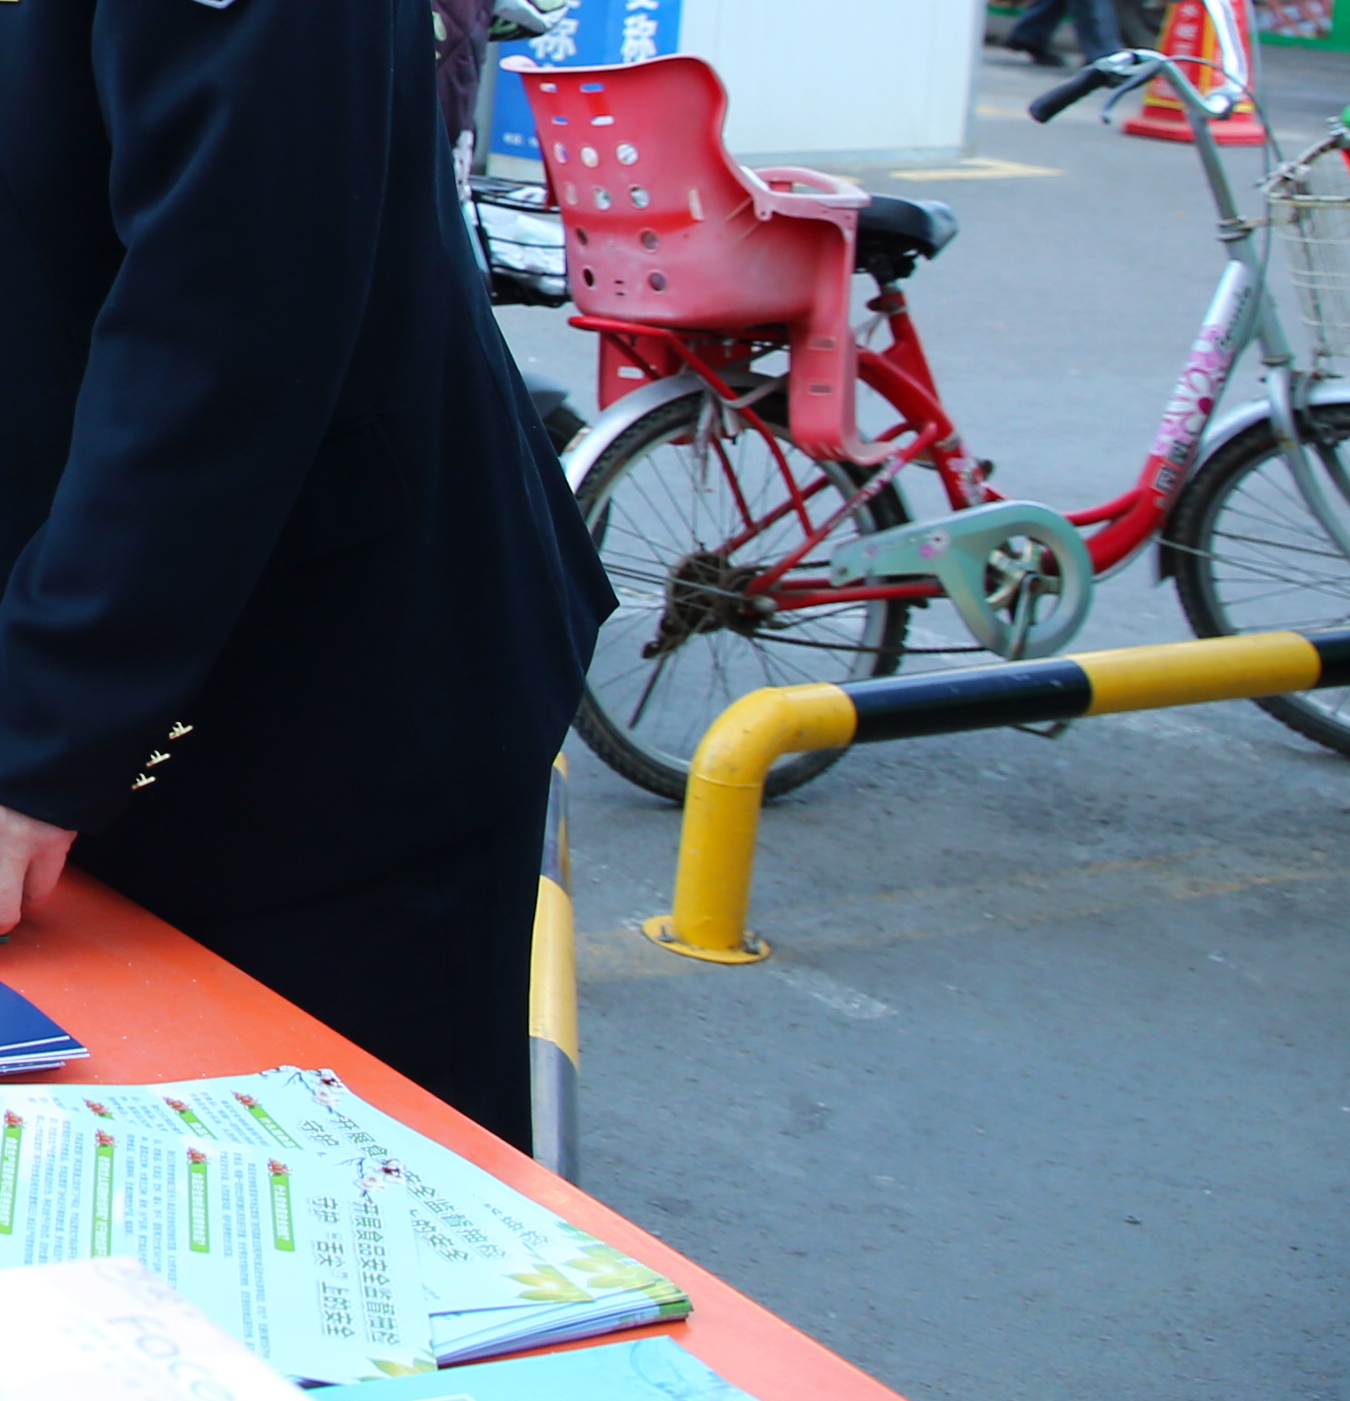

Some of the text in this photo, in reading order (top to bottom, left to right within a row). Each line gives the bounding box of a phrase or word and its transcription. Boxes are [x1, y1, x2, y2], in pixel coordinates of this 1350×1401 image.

[329, 1114, 507, 1260] 开展食安全监督抽检
[352, 1197, 401, 1345] 开展食品安全监督抽检
